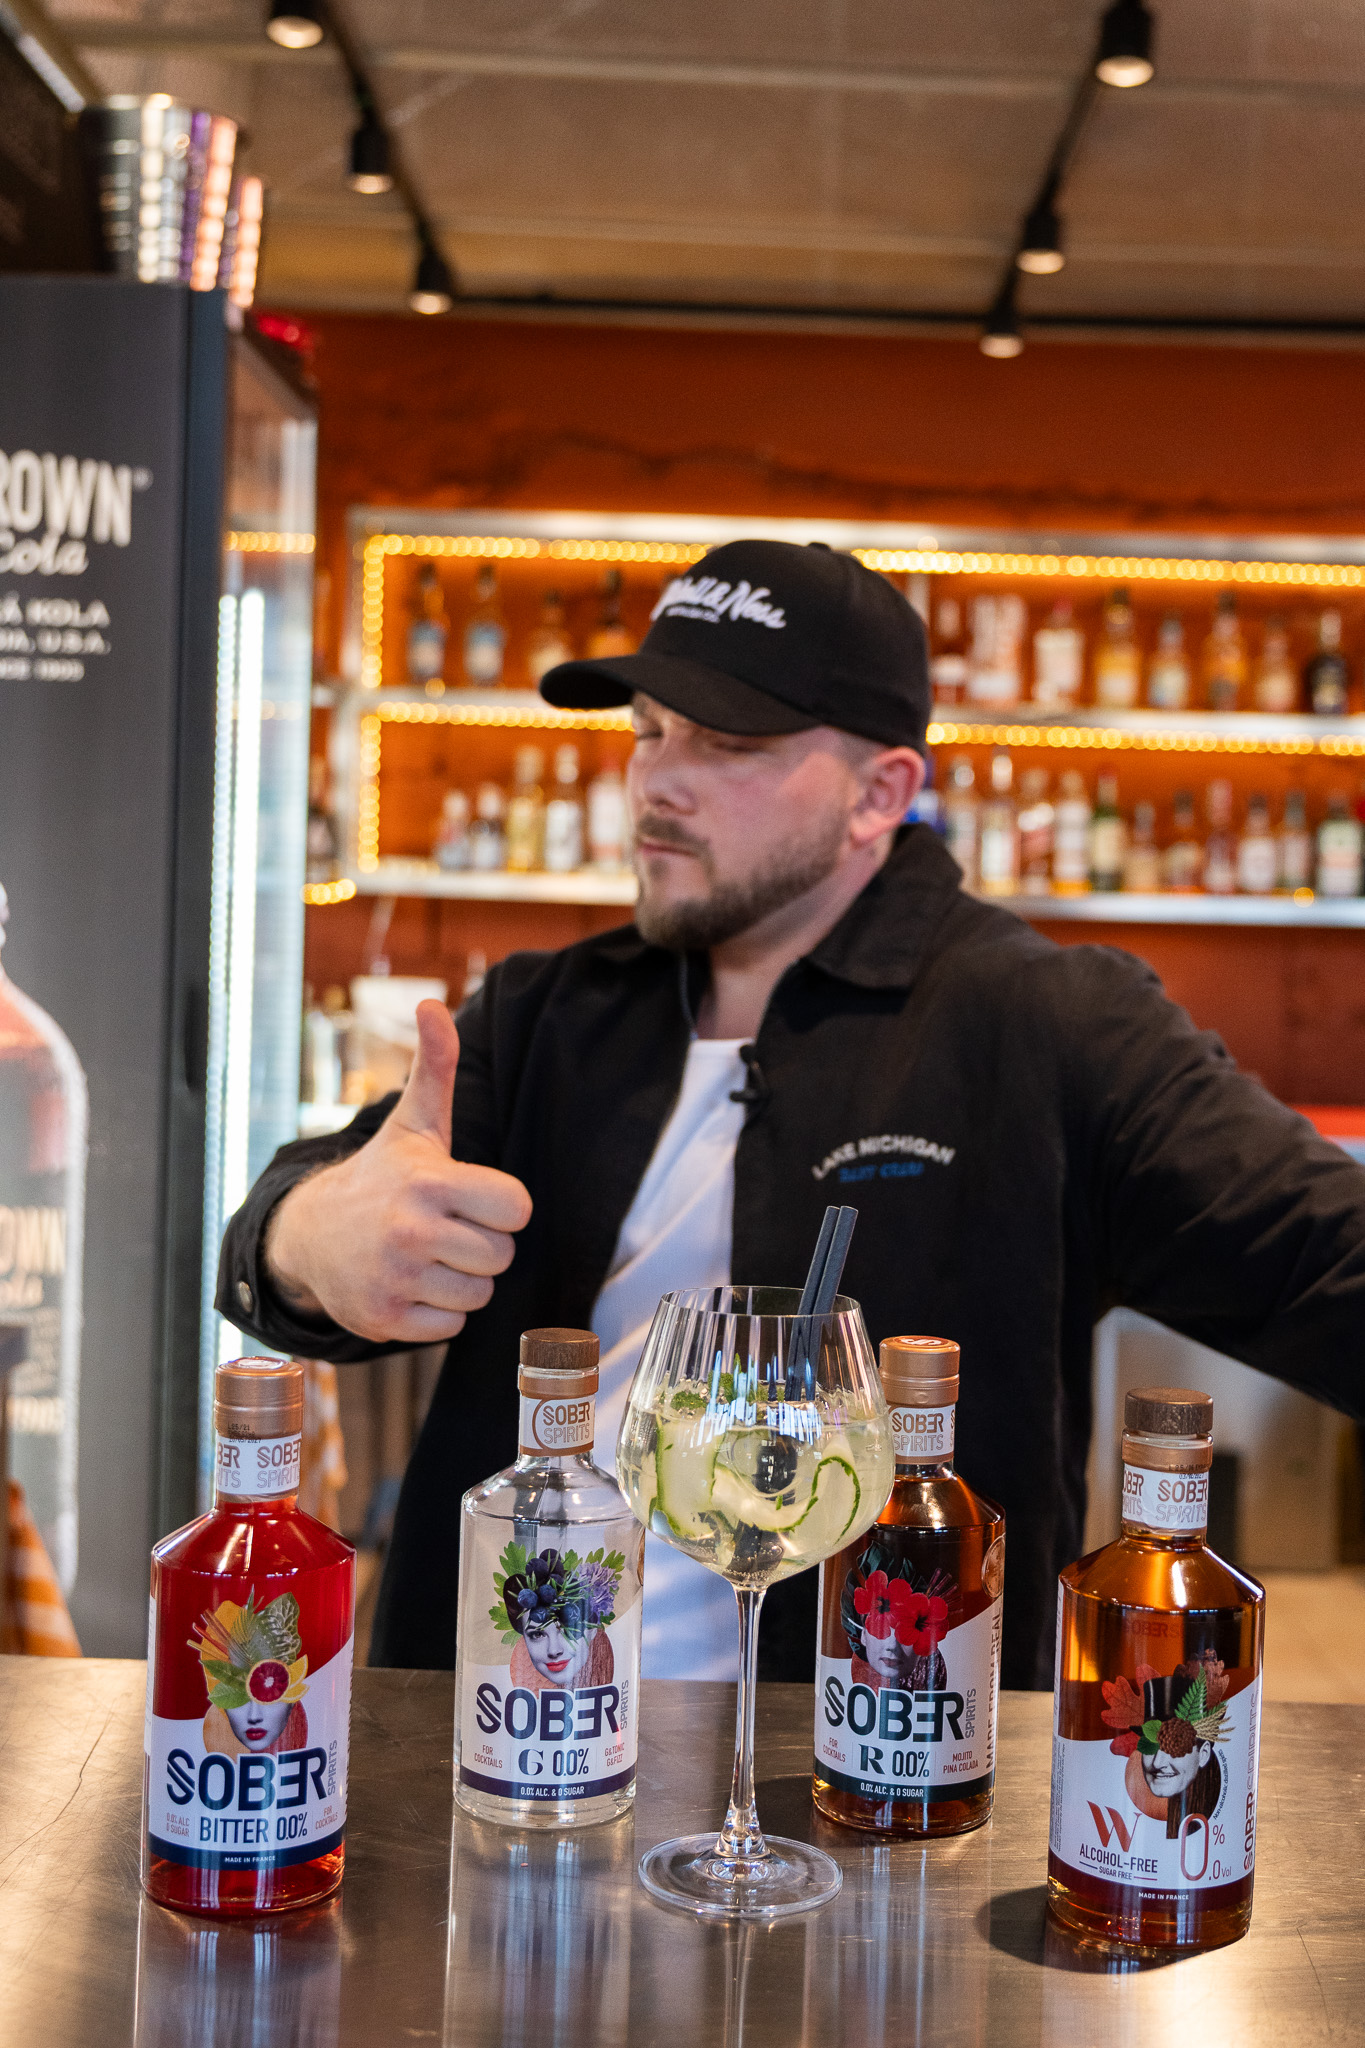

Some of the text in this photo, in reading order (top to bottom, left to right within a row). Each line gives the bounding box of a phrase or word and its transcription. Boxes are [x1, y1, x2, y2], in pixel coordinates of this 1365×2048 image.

[0, 448, 132, 547] OWN
[812, 1142, 857, 1180] LAKE
[858, 1134, 956, 1166] MICHIGAN
[543, 1401, 590, 1426] SOBER
[892, 1412, 944, 1433] SOBER
[544, 1423, 590, 1444] SPIRITS
[892, 1434, 944, 1451] SPIRITS
[1157, 1479, 1208, 1503] SOBER
[476, 1683, 620, 1741] SOBER
[620, 1679, 629, 1731] SPIRITS
[825, 1676, 964, 1743] SOBER
[965, 1688, 977, 1739] SPIRITS
[482, 1744, 493, 1755] FOR
[829, 1737, 838, 1747] FOR
[474, 1753, 503, 1769] COCKTAILS
[518, 1748, 589, 1777] G 0.0%
[823, 1745, 846, 1762] COCKTAILS
[858, 1743, 929, 1778] R 0.0%
[952, 1751, 972, 1762] MOJITO
[328, 1740, 337, 1796] SPIRITS
[943, 1760, 978, 1774] PINA COLADA
[167, 1747, 327, 1811] SOBER
[861, 1782, 924, 1797] 0.0% ALC. & 0 SUGAR
[521, 1786, 534, 1796] 0.0%
[535, 1788, 550, 1797] ALC.
[558, 1788, 563, 1796] 0
[563, 1786, 585, 1796] SUGAR
[177, 1815, 190, 1826] ALC
[315, 1812, 338, 1830] COCKTAILS
[324, 1805, 333, 1816] FOR
[171, 1825, 190, 1837] SUGAR
[200, 1812, 307, 1843] BITTER 0.0%
[1086, 1800, 1142, 1852] W
[252, 1855, 276, 1863] FRANCE
[1079, 1843, 1158, 1874] ALCOHOL-FREE
[1099, 1866, 1132, 1880] SUGAR FREE
[1221, 1867, 1232, 1878] Vol
